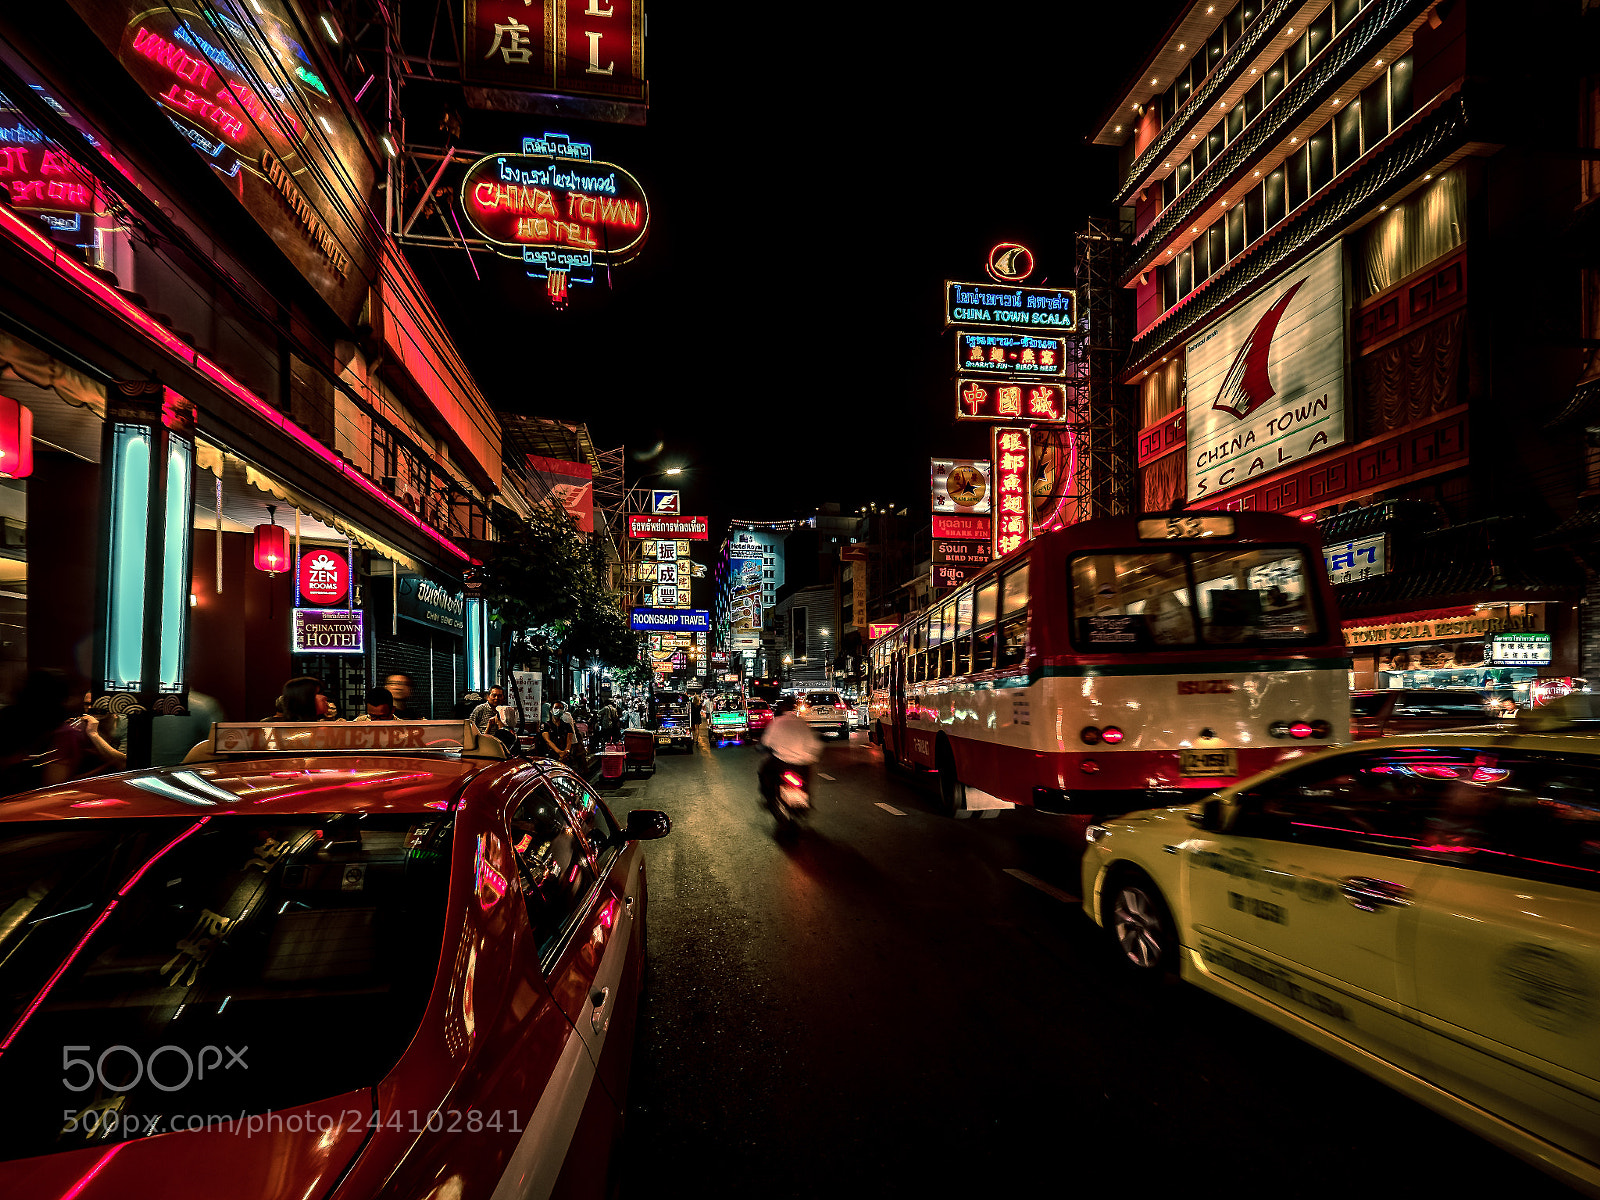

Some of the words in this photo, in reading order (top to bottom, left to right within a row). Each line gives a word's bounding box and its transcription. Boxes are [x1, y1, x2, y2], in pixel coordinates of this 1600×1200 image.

[484, 0, 533, 64] 店
[475, 182, 555, 216] CHINA
[568, 192, 639, 227] TOWN
[517, 217, 597, 247] HOTEL
[953, 307, 991, 321] CHINA
[993, 310, 1029, 323] TOWN
[1031, 312, 1071, 326] SCALA
[1196, 430, 1256, 468] CHINA
[1266, 393, 1328, 437] TOWN
[1196, 430, 1328, 496] SCALA
[938, 519, 972, 531] หูฉลาม
[974, 530, 989, 538] FIN
[938, 542, 968, 554] รังนก
[967, 555, 989, 563] NEST
[309, 570, 338, 583] ZEN
[309, 582, 338, 590] ROOMS
[633, 613, 679, 625] ROONGSARP
[680, 614, 707, 626] TRAVEL
[305, 623, 363, 632] CHINATOWN
[1352, 629, 1387, 643] TOWN
[1389, 625, 1432, 640] SCALA
[1434, 612, 1537, 637] RESTAURANT
[306, 633, 361, 647] HOTEL
